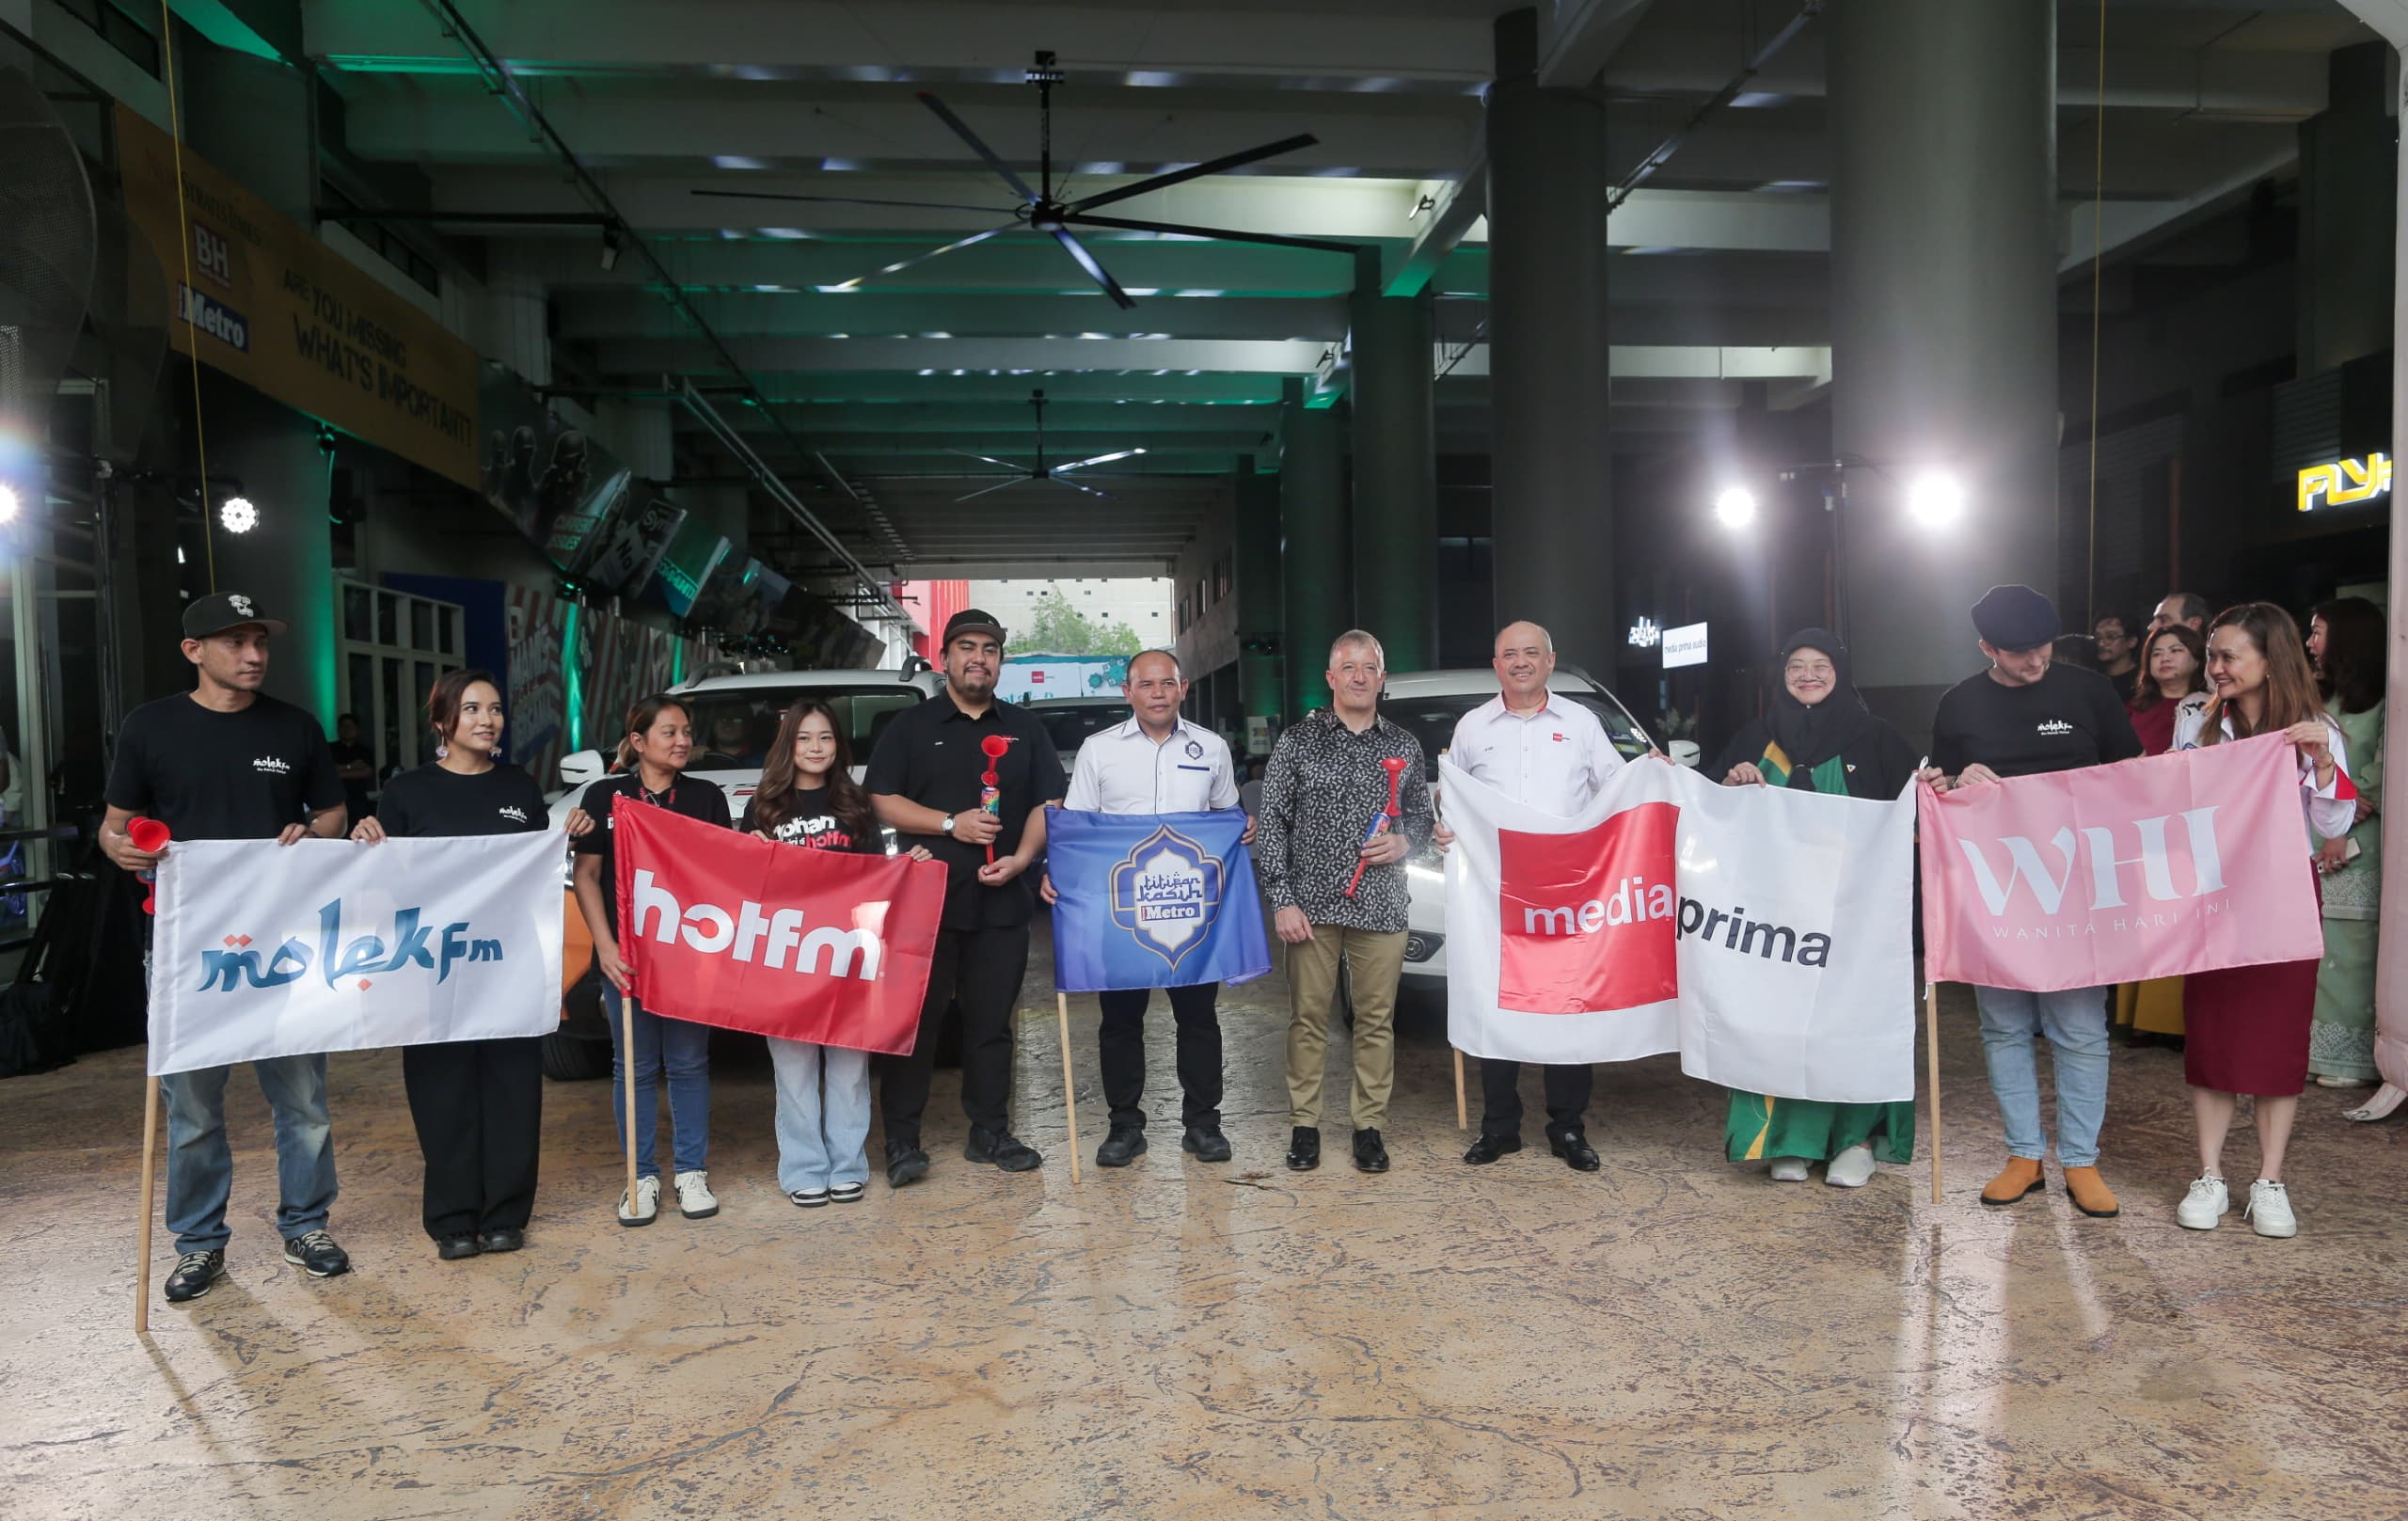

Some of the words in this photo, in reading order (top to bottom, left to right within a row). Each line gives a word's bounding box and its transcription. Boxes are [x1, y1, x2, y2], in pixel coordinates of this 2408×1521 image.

[194, 225, 230, 280] BH
[183, 285, 246, 349] Metro
[284, 268, 309, 302] ARE
[311, 285, 343, 331] YOU
[346, 308, 408, 370] MISSING
[293, 310, 373, 392] WHAT'S
[1956, 805, 2228, 916] WHI
[1146, 905, 1196, 920] Metro
[1524, 877, 1674, 936] media
[1676, 895, 1832, 968] prima
[1993, 923, 2097, 940] WANITA
[2114, 913, 2179, 931] HARI
[2196, 898, 2230, 918] INI
